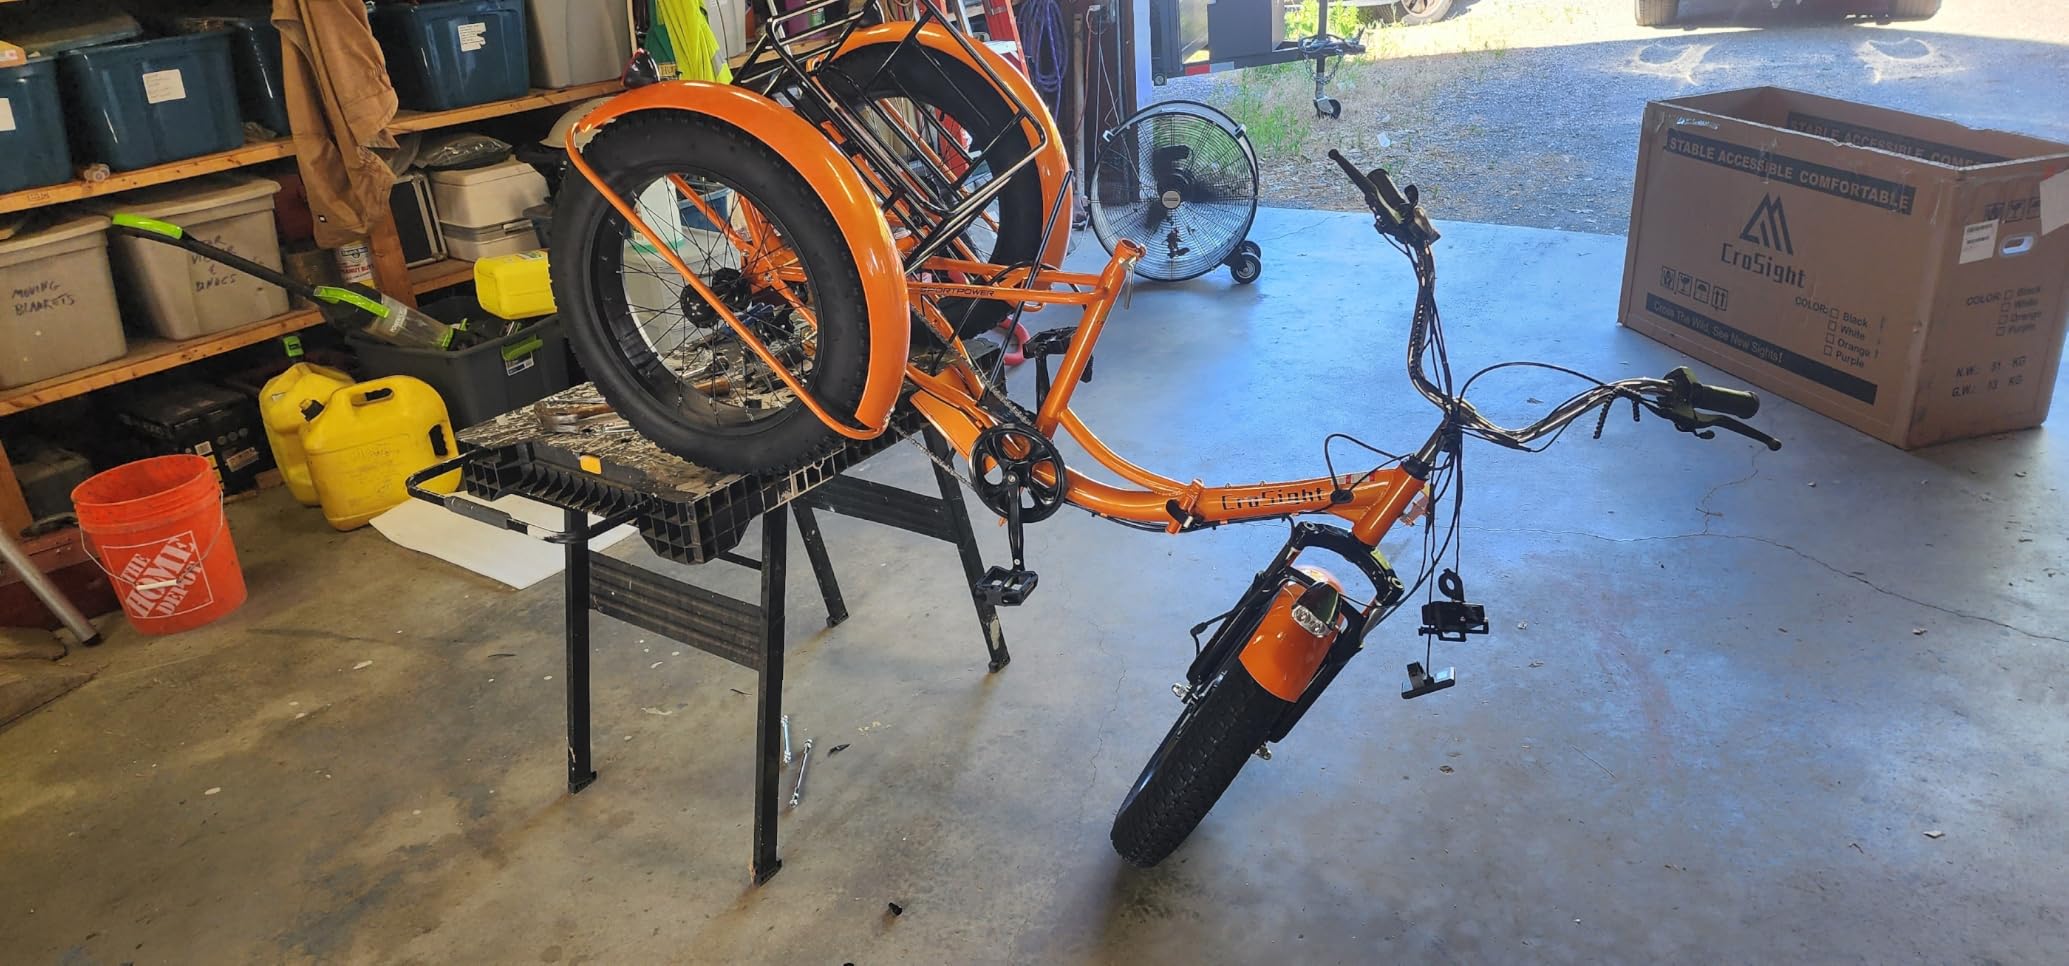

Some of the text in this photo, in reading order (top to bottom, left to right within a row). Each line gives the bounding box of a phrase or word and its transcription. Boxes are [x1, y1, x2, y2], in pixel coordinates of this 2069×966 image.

[1669, 137, 1910, 209] STABLE ACCESSIBLE COMFORTABLE
[1721, 242, 1807, 289] CroSight
[12, 280, 61, 299] MOVING
[920, 286, 995, 298] SPORTPOWER
[1842, 311, 1869, 328] Black
[1676, 309, 1691, 322] The
[1712, 325, 1729, 339] See
[1730, 331, 1750, 349] New
[1751, 341, 1783, 363] Sights!
[1840, 325, 1865, 341] White
[1837, 337, 1871, 357] Orange
[1835, 350, 1865, 369] Purple
[1221, 487, 1325, 511] CroSight
[119, 553, 151, 584] THE
[126, 536, 197, 618] HOME
[155, 560, 202, 616] DEPOT
